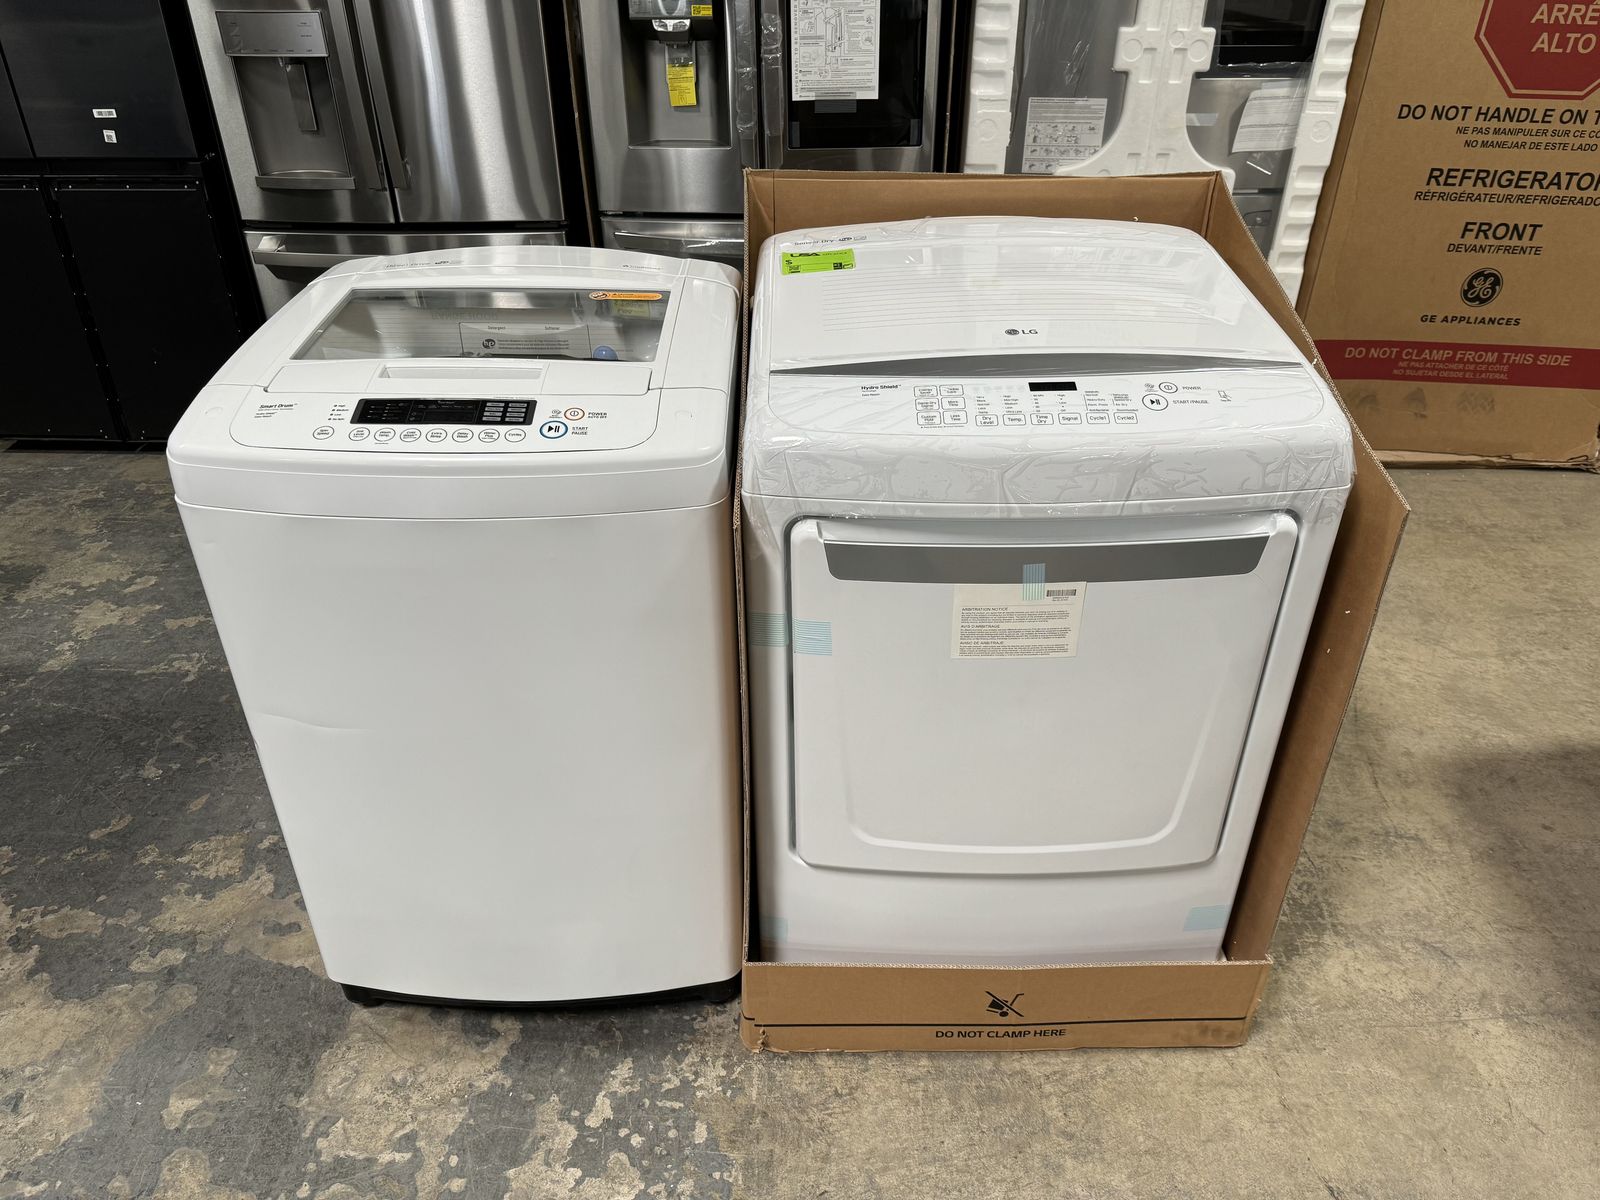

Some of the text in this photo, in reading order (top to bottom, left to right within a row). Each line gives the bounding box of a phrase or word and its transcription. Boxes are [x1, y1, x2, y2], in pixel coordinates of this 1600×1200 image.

[1531, 32, 1596, 54] ALTO
[1397, 104, 1426, 120] DO
[1431, 105, 1472, 121] NOT
[1475, 106, 1555, 124] HANDLE
[1560, 108, 1588, 125] ON
[1456, 126, 1470, 134] NE
[1471, 126, 1491, 135] PAS
[1492, 127, 1548, 137] MANIPULER
[1550, 129, 1571, 138] SUR
[1573, 130, 1588, 138] CE
[1464, 140, 1598, 152] NO MANEJAR DE ESTE LADO
[1460, 221, 1543, 242] FRONT
[1447, 243, 1543, 256] DEVANT/FRENTE
[1420, 314, 1521, 326] GE APPLIANCES
[1344, 347, 1572, 366] DO NOT CLAMP FROM THIS SIDE
[1426, 362, 1464, 370] ATTACHER
[935, 1029, 1067, 1039] DO NOT CLAMP HERE
